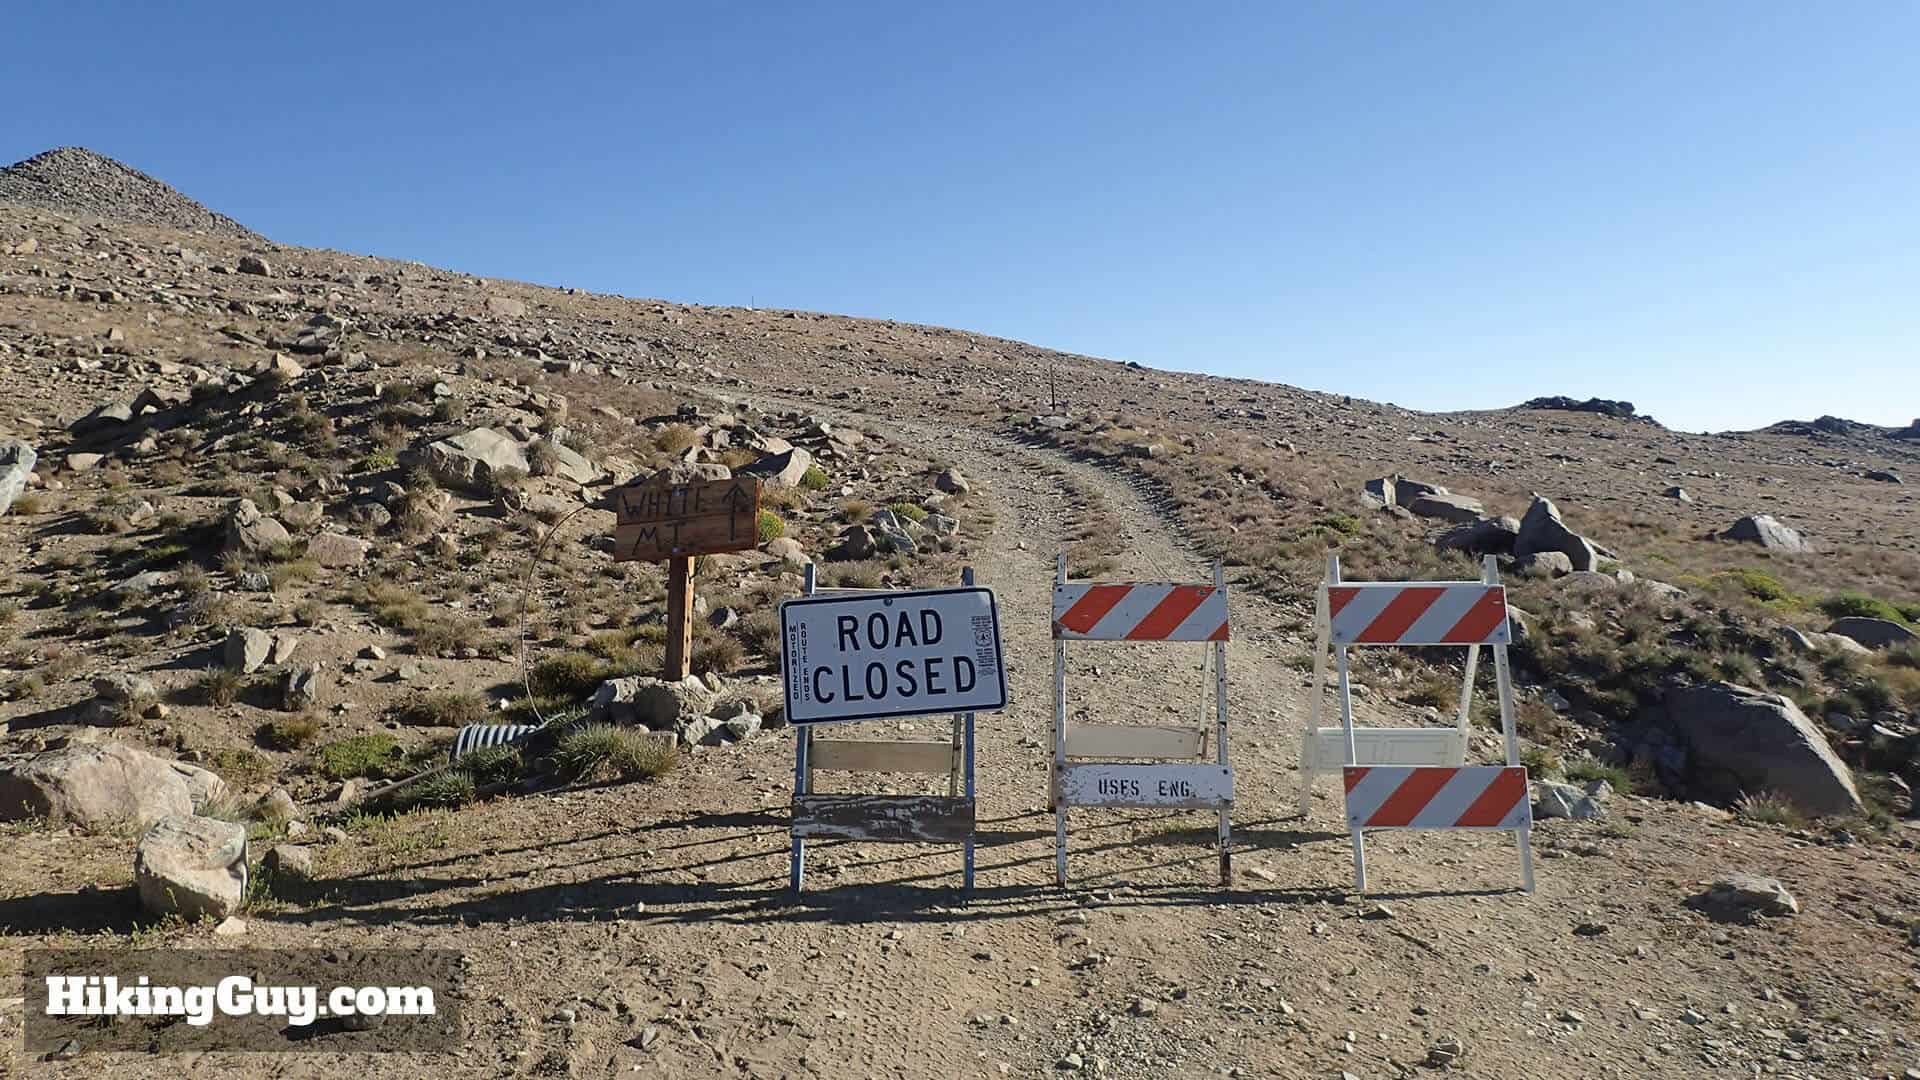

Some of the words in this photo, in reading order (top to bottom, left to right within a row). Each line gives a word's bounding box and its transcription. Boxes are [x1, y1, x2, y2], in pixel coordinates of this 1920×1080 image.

[622, 486, 709, 517] WHITE
[800, 622, 808, 664] ROUTE
[837, 609, 943, 652] ROAD
[789, 625, 799, 700] MOTORIZED
[813, 656, 977, 704] CLOSED
